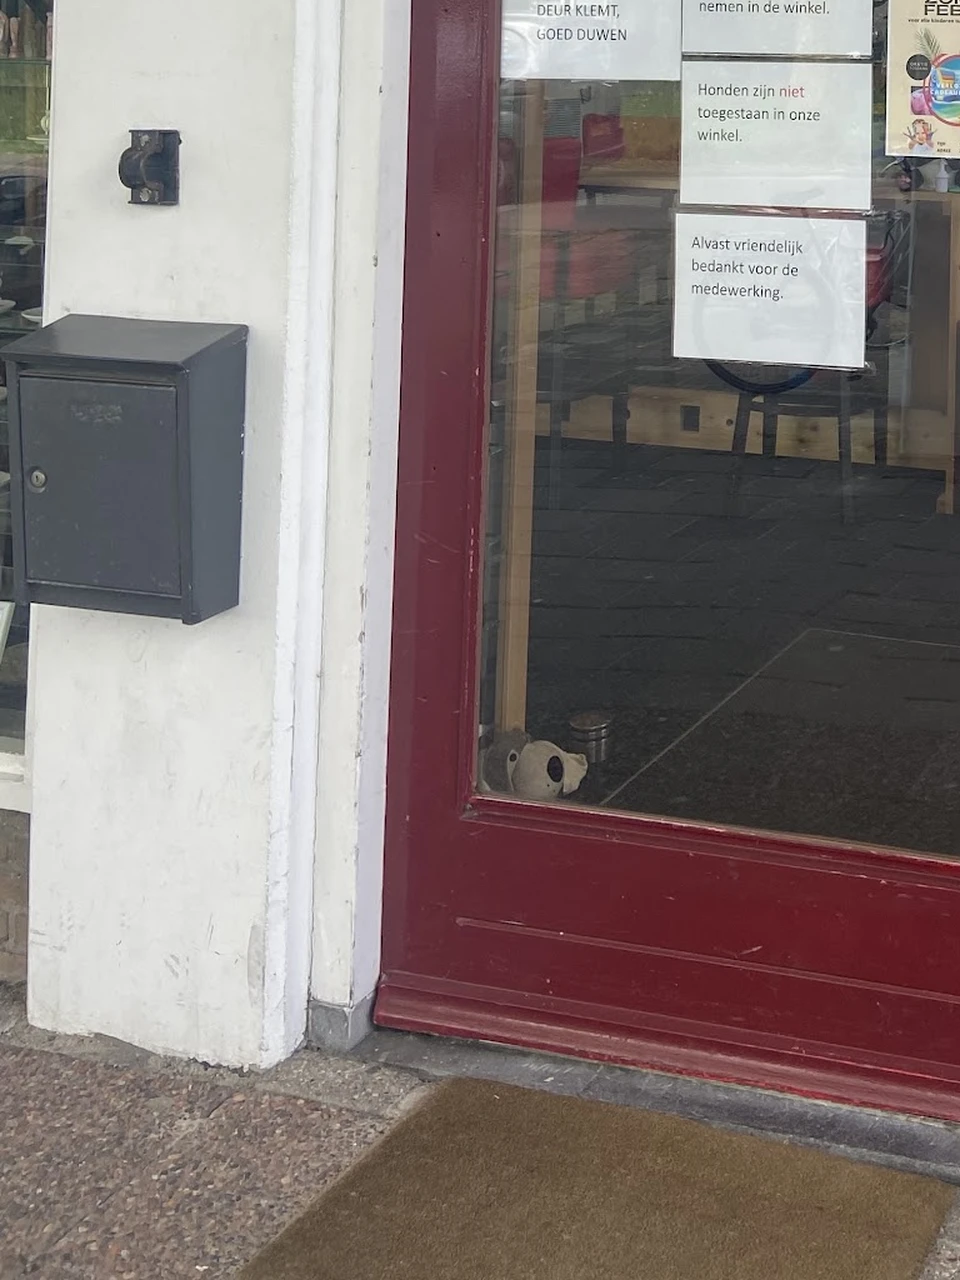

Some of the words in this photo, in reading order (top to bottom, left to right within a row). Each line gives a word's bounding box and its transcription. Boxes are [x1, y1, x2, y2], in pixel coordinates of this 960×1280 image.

[536, 3, 572, 18] DEUR
[575, 3, 620, 20] KLEMT,
[699, 0, 744, 14] nemen
[748, 0, 760, 14] in
[763, 0, 781, 14] de
[784, 0, 830, 16] winkel.
[536, 28, 574, 42] GOED
[576, 28, 628, 42] DUWEN
[698, 83, 749, 98] Honden
[752, 84, 775, 100] zijn
[779, 85, 805, 99] niet
[698, 107, 769, 123] toegestaan
[773, 107, 785, 121] in
[789, 109, 821, 122] onze
[697, 128, 743, 143] winkel.
[691, 236, 731, 251] Alvast
[733, 238, 803, 255] vriendelijk
[691, 259, 745, 274] bedankt
[748, 264, 778, 276] voor
[782, 263, 799, 277] de
[691, 282, 784, 302] medewerking.
